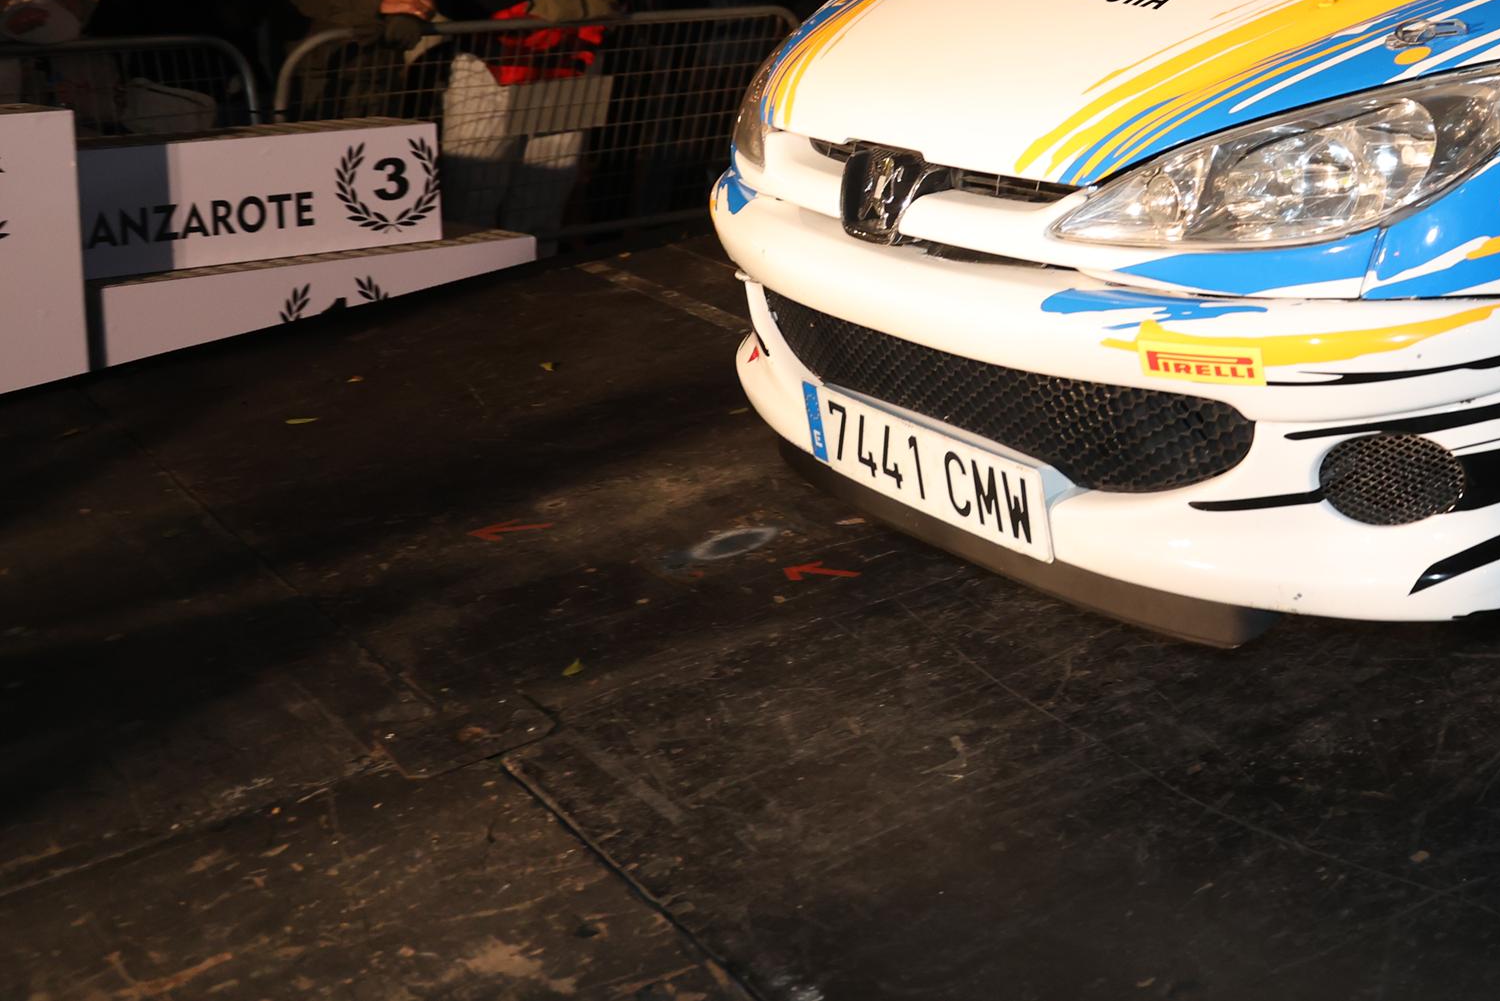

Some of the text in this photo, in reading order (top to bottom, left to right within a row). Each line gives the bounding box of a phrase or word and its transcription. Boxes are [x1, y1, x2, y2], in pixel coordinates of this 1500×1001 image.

[374, 157, 410, 200] 3
[1146, 350, 1255, 379] PIRELLI
[813, 429, 823, 449] E
[828, 400, 1032, 544] 7441 CMW
